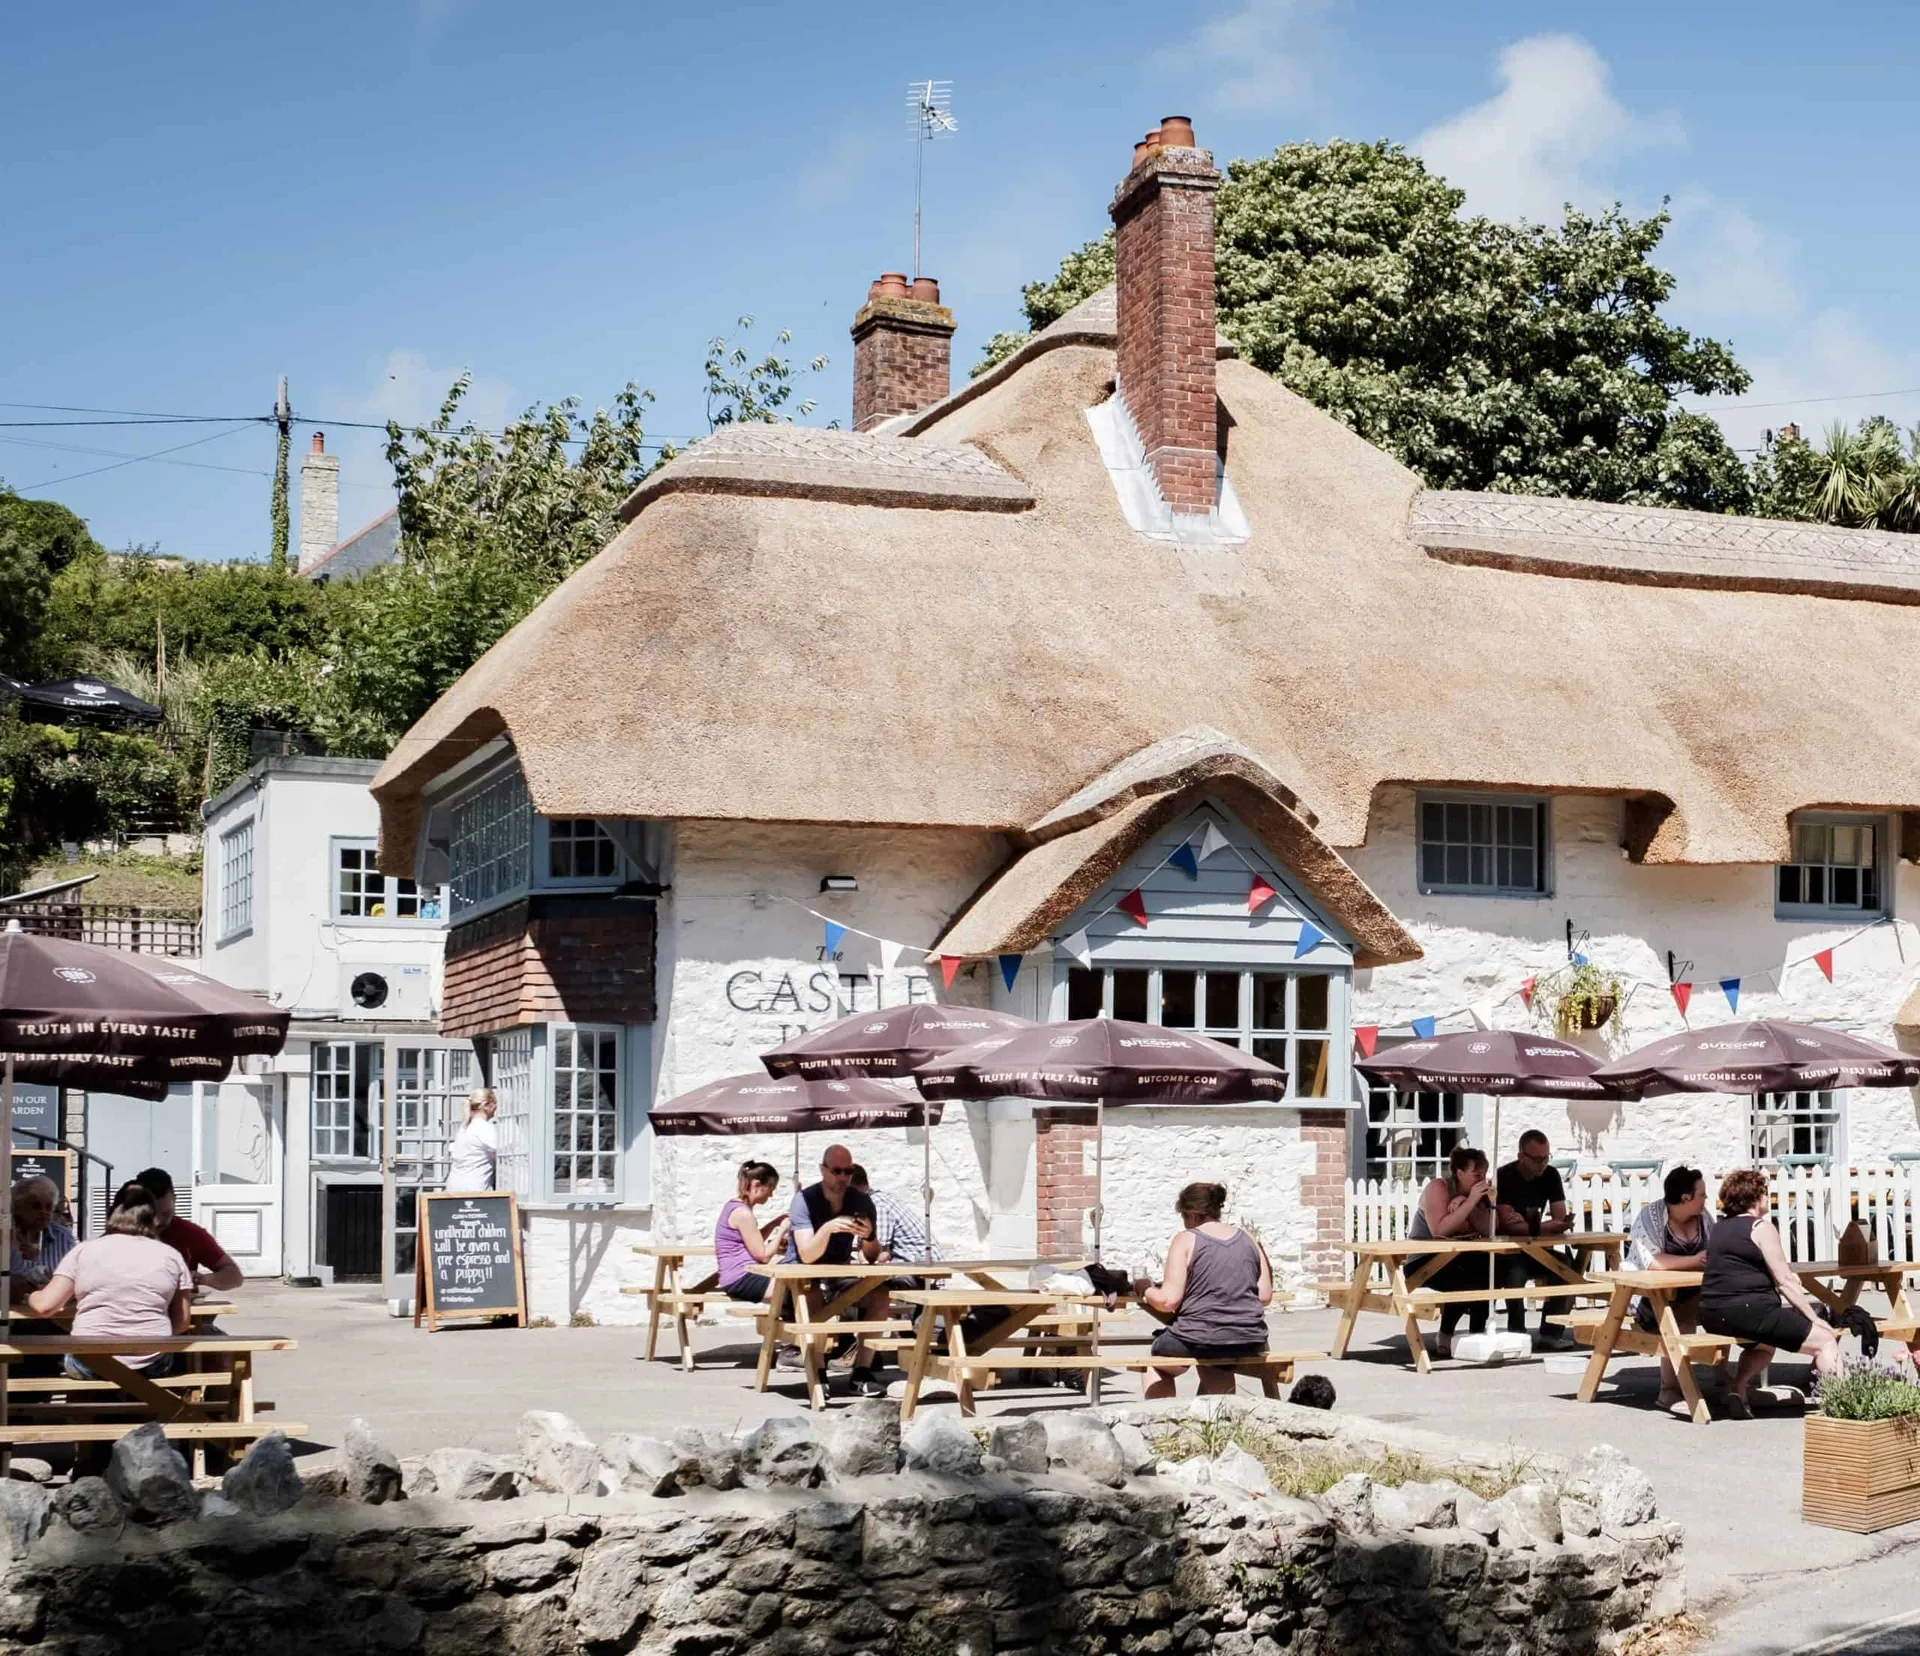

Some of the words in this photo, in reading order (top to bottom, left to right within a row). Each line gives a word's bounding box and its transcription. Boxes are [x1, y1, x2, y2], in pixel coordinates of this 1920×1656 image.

[18, 1024, 71, 1036] TRUTH
[77, 1023, 95, 1033] IN
[100, 1023, 147, 1036] EVERY
[153, 1026, 198, 1039] TASTE
[50, 1054, 92, 1063] EVERY
[96, 1055, 134, 1067] TASTE
[800, 1061, 828, 1069] TRUTH
[845, 1058, 871, 1066] EVERY
[874, 1058, 897, 1066] TASTE
[1683, 1073, 1762, 1081] BUTCOMBE.COM
[1800, 1069, 1827, 1079] TRUTH
[1829, 1067, 1839, 1075] IN
[1868, 1067, 1892, 1076] TASTE
[978, 1072, 1012, 1083] TRUTH
[1032, 1072, 1064, 1081] EVERY
[1068, 1074, 1099, 1086] TASTE
[1138, 1075, 1217, 1085] BUTCOMBE.COM
[1417, 1075, 1445, 1083] TRUTH
[1461, 1076, 1487, 1084] EVERY
[1490, 1077, 1515, 1085] TASTE
[12, 1096, 24, 1104] IN
[25, 1096, 47, 1104] OUR
[12, 1106, 44, 1115] ARDEN
[820, 1112, 846, 1122] TRUTH
[887, 1110, 908, 1118] TASTE
[721, 1115, 788, 1125] BUTCOMBE.COM
[455, 1239, 466, 1252] be
[466, 1242, 490, 1257] given
[493, 1242, 500, 1253] a
[437, 1255, 454, 1269] free
[456, 1254, 492, 1268] espresso
[495, 1250, 511, 1264] and
[441, 1269, 448, 1280] a
